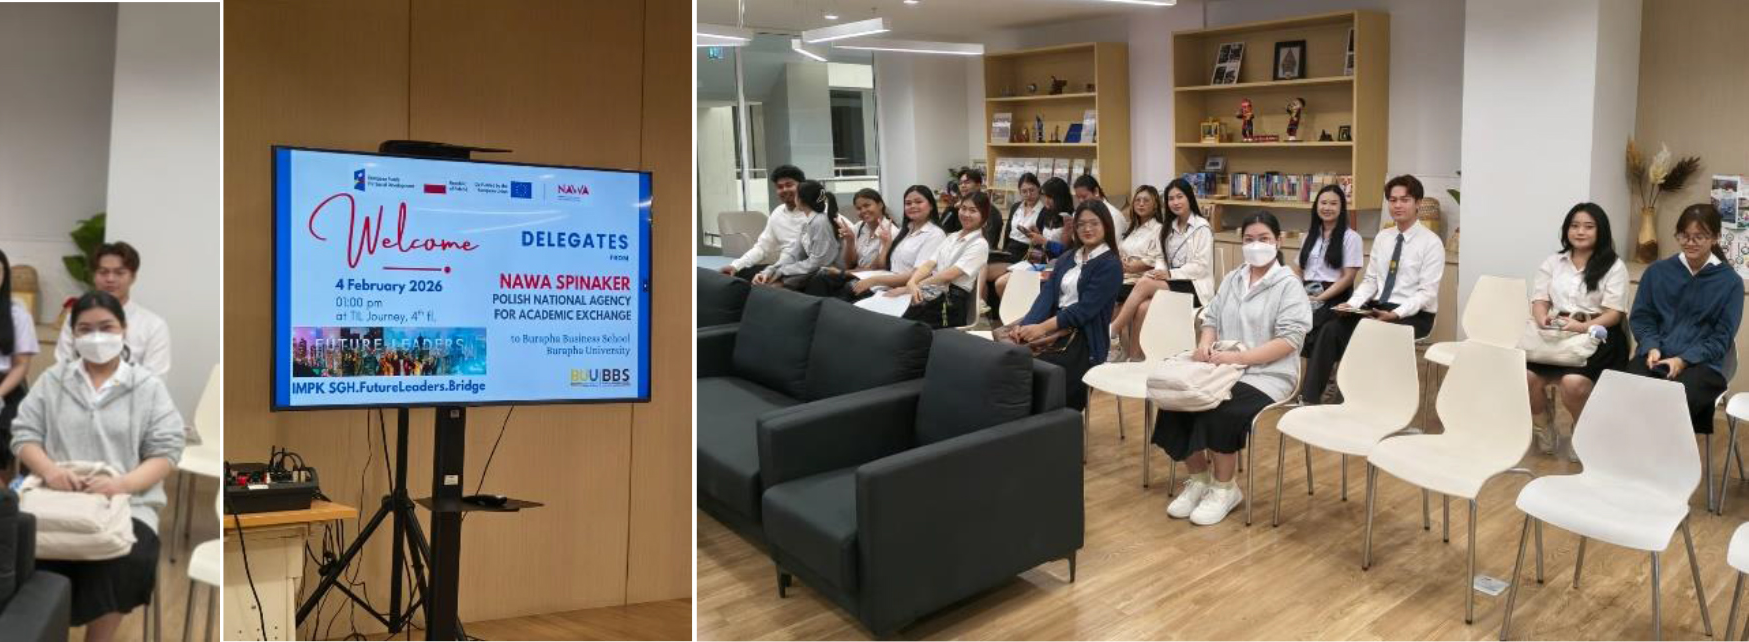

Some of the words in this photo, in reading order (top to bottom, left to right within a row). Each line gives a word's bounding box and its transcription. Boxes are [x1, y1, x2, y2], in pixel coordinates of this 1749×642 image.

[557, 184, 590, 196] NAWA
[308, 192, 480, 269] Welcome
[521, 230, 629, 250] DELEGATES
[335, 279, 345, 291] 4
[347, 279, 406, 295] February
[409, 280, 443, 292] 2026
[499, 273, 552, 290] NAWA
[556, 275, 631, 291] SPINAKER
[335, 297, 363, 308] 01:00
[367, 300, 383, 310] pm
[492, 293, 531, 305] POLISH
[533, 294, 587, 306] NATIONAL
[589, 295, 632, 306] AGENCY
[335, 311, 347, 321] at
[366, 310, 409, 324] Journey,
[494, 308, 516, 320] FOR
[519, 309, 573, 321] ACADEMIC
[576, 309, 632, 321] EXCHANGE
[315, 338, 383, 351] FUTURE
[391, 338, 464, 351] LEADERS
[511, 335, 520, 344] to
[522, 334, 561, 346] Burapha
[562, 334, 600, 344] Business
[601, 333, 631, 344] School
[547, 346, 584, 357] Burapha
[585, 346, 631, 357] University
[602, 368, 630, 382] BBS
[292, 382, 325, 395] IMPK
[329, 380, 486, 394] SGH.FutureLeaders.Bridge
